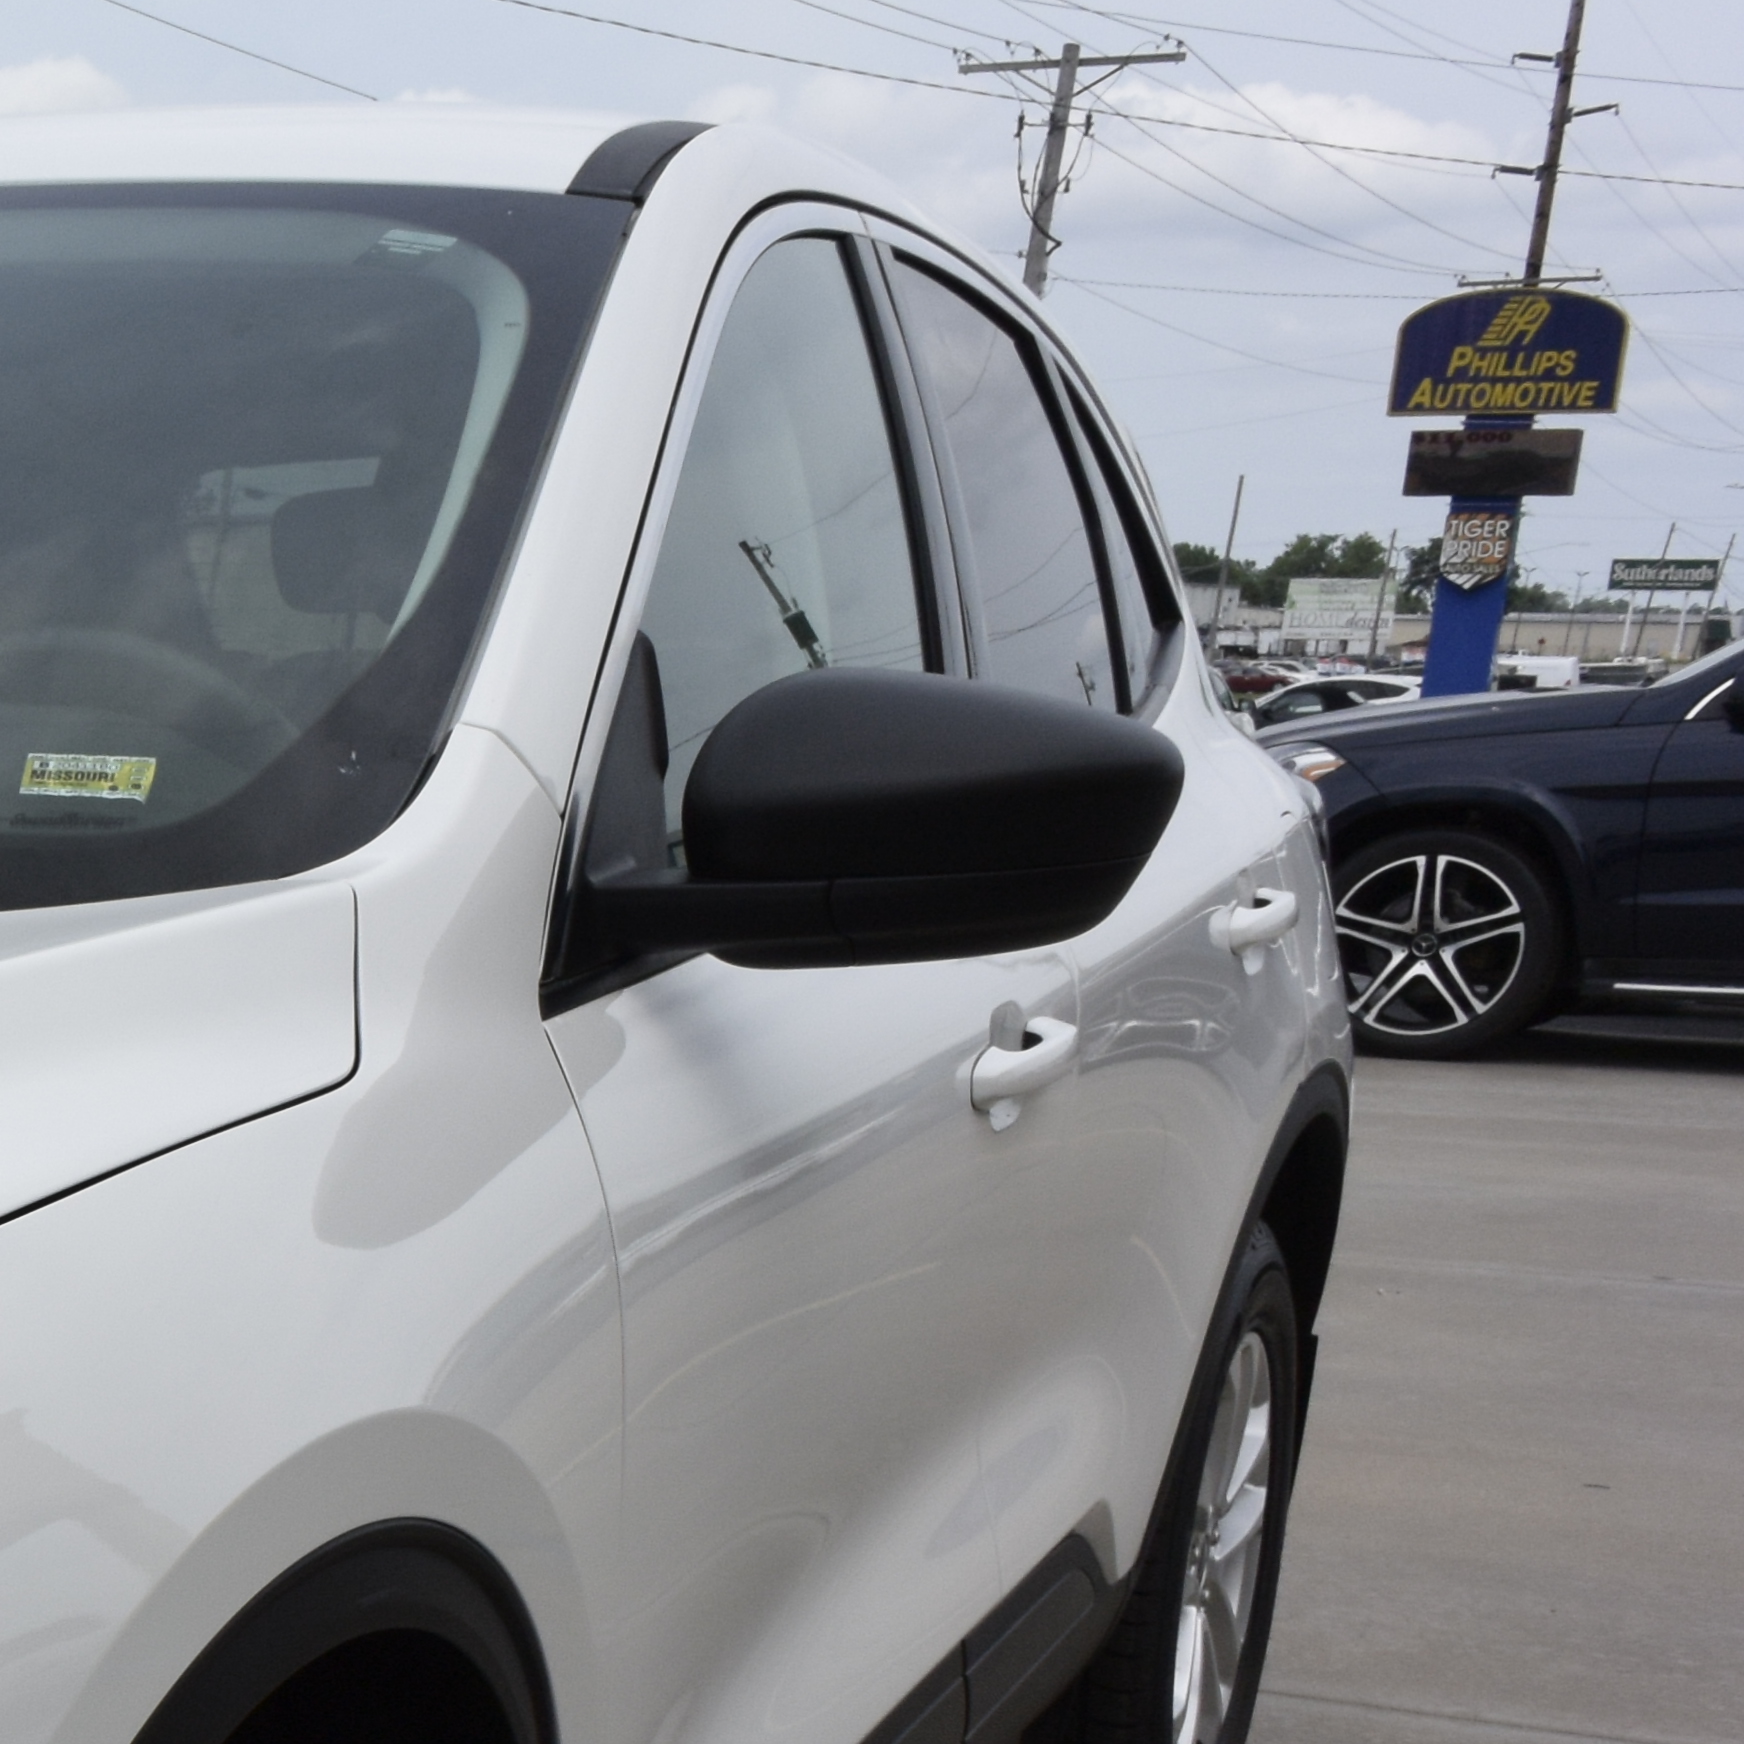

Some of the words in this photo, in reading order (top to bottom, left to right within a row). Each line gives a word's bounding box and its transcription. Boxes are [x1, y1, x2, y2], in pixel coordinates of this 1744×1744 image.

[1446, 346, 1579, 378] PHILLIPS
[1407, 377, 1600, 410] AUTOMOTIVE
[1450, 519, 1510, 538] TIGER
[1445, 540, 1507, 558] PRIDE
[1345, 611, 1390, 630] desin
[30, 769, 116, 783] MISSOURI
